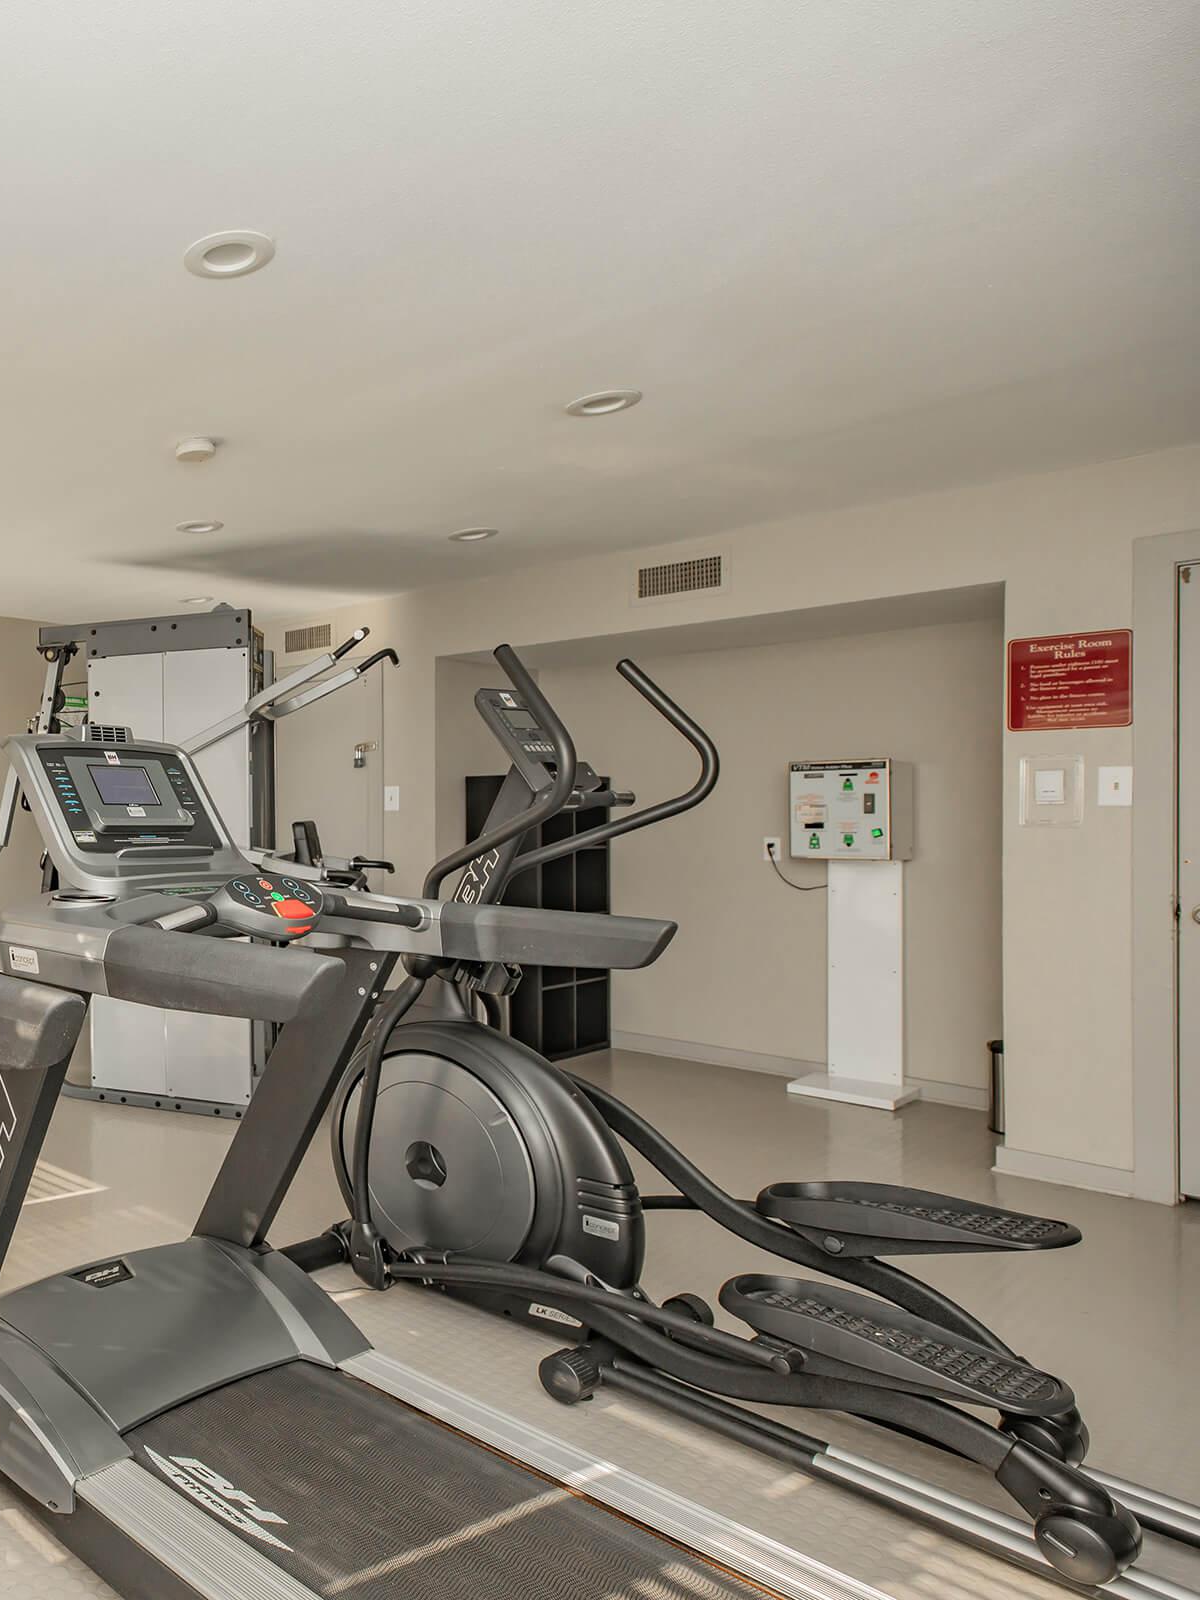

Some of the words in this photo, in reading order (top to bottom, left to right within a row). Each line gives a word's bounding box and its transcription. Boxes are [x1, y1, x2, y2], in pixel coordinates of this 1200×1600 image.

[1030, 642, 1076, 653] Exercise
[1078, 639, 1113, 649] Room
[1054, 651, 1086, 659] Rules
[536, 1306, 547, 1316] LK
[169, 1455, 289, 1525] BH
